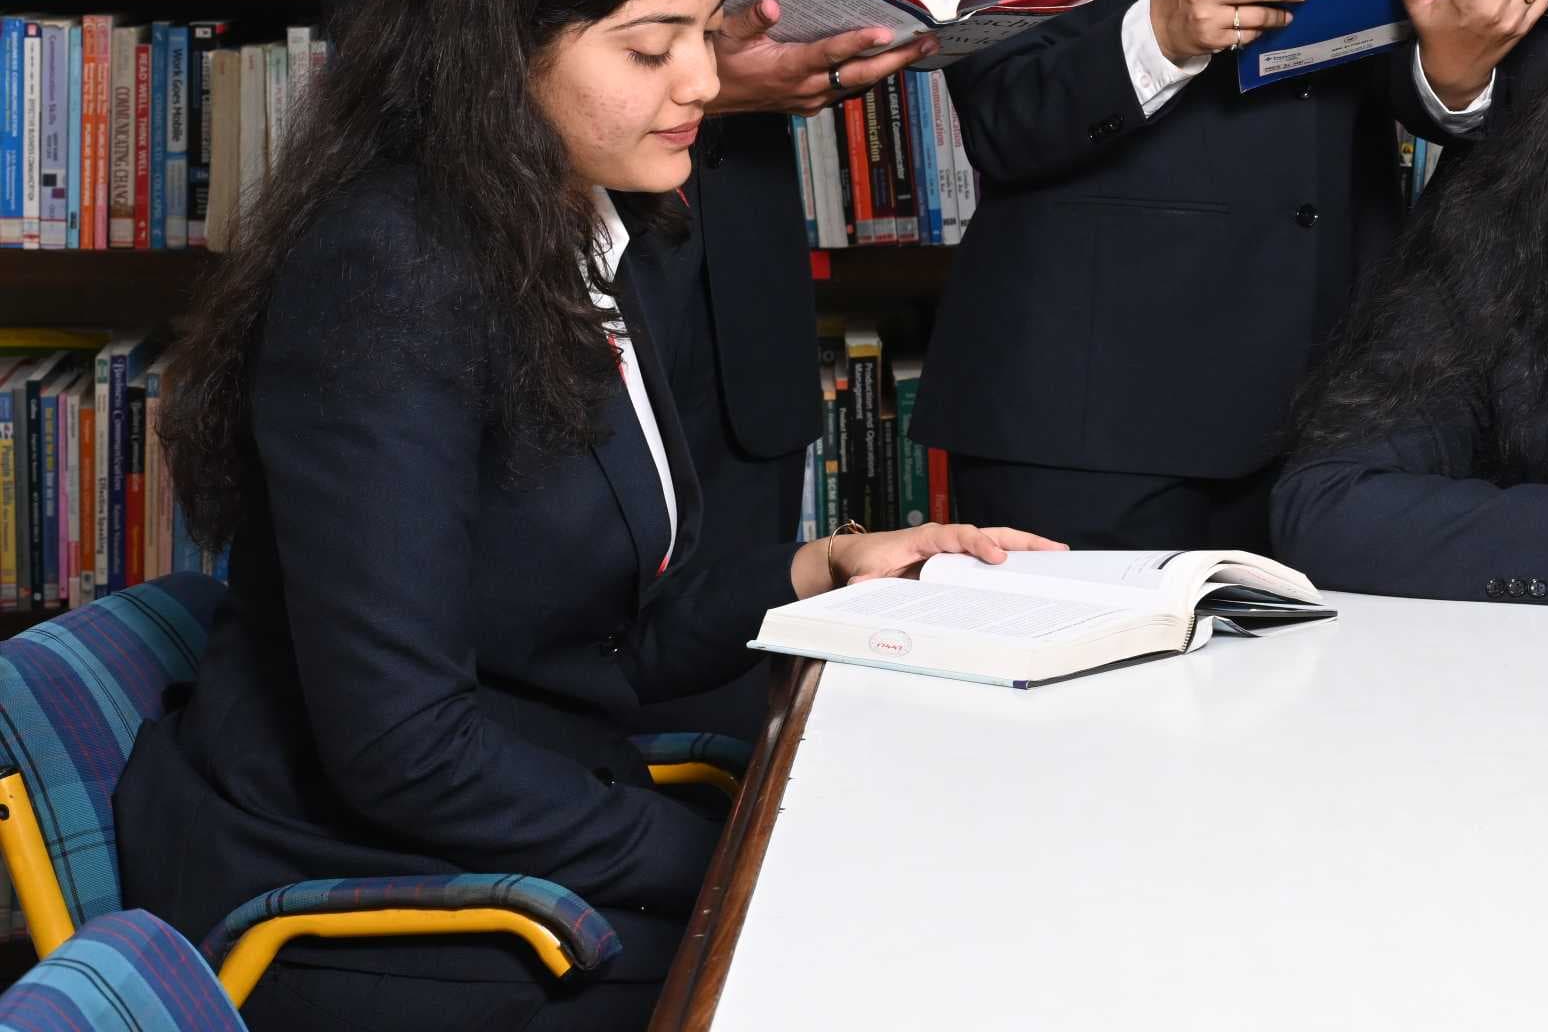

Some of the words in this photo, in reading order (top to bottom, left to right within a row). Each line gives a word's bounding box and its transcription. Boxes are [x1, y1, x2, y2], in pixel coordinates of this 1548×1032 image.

[137, 53, 148, 80] READ
[172, 49, 183, 77] Work
[137, 84, 148, 113] WELL,
[172, 80, 183, 103] Goes
[890, 94, 900, 119] GREAT
[931, 71, 946, 146] Communication
[114, 87, 130, 166] COMMUNICATING
[137, 117, 148, 146] THINK
[172, 106, 183, 142] Mobile
[137, 151, 148, 176] WELL
[892, 122, 906, 179] Communicator
[114, 169, 130, 209] CHANGE
[112, 362, 124, 407] Business
[853, 363, 865, 419] Management
[863, 363, 874, 406] Production
[865, 408, 874, 421] and
[112, 411, 124, 491] Communication
[865, 425, 876, 477] Operations
[97, 477, 107, 515] Effective
[95, 518, 106, 554] Speaking
